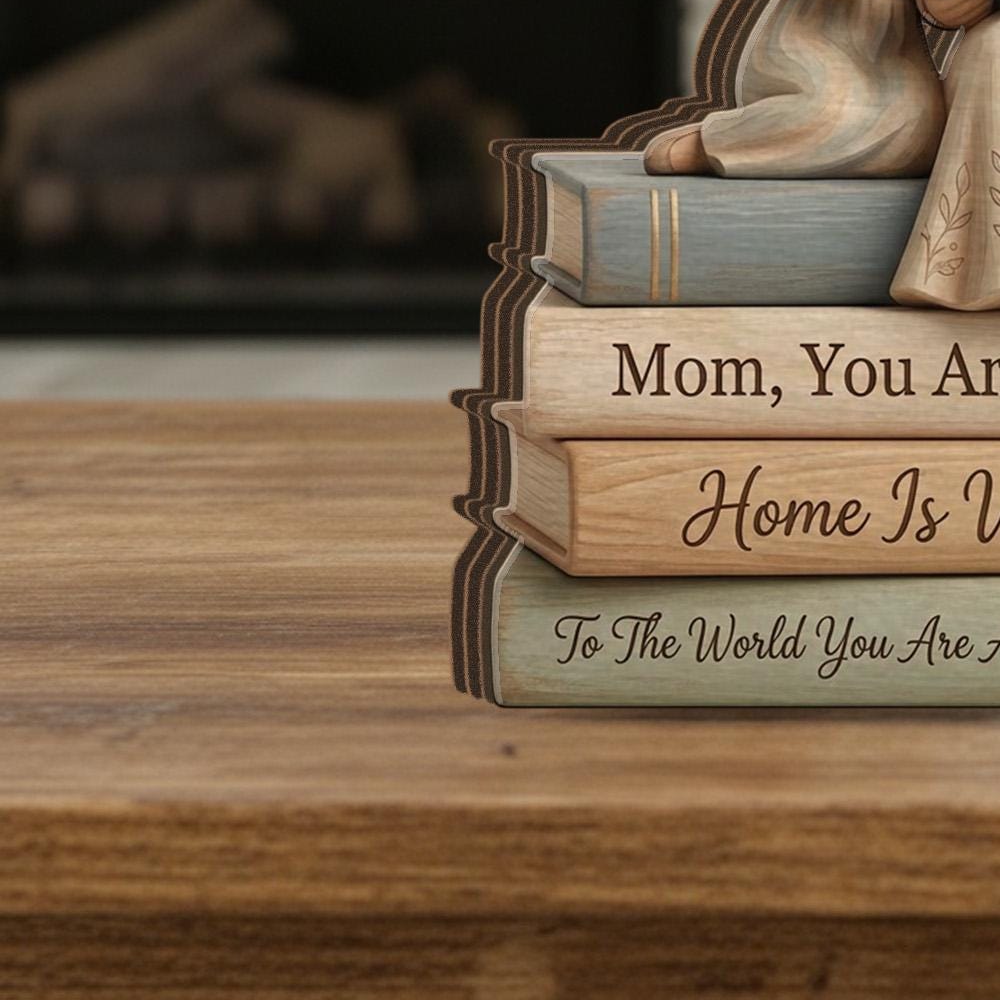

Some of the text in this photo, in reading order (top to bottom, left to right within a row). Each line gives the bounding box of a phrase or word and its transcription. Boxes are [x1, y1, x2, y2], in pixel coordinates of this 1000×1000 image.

[611, 342, 784, 408] Mom,
[800, 342, 916, 397] You
[681, 465, 871, 552] Home
[881, 466, 950, 544] Is
[554, 614, 603, 665] To
[611, 611, 681, 664] The
[688, 613, 806, 662] World
[816, 616, 894, 680] You
[898, 615, 974, 664] Are
